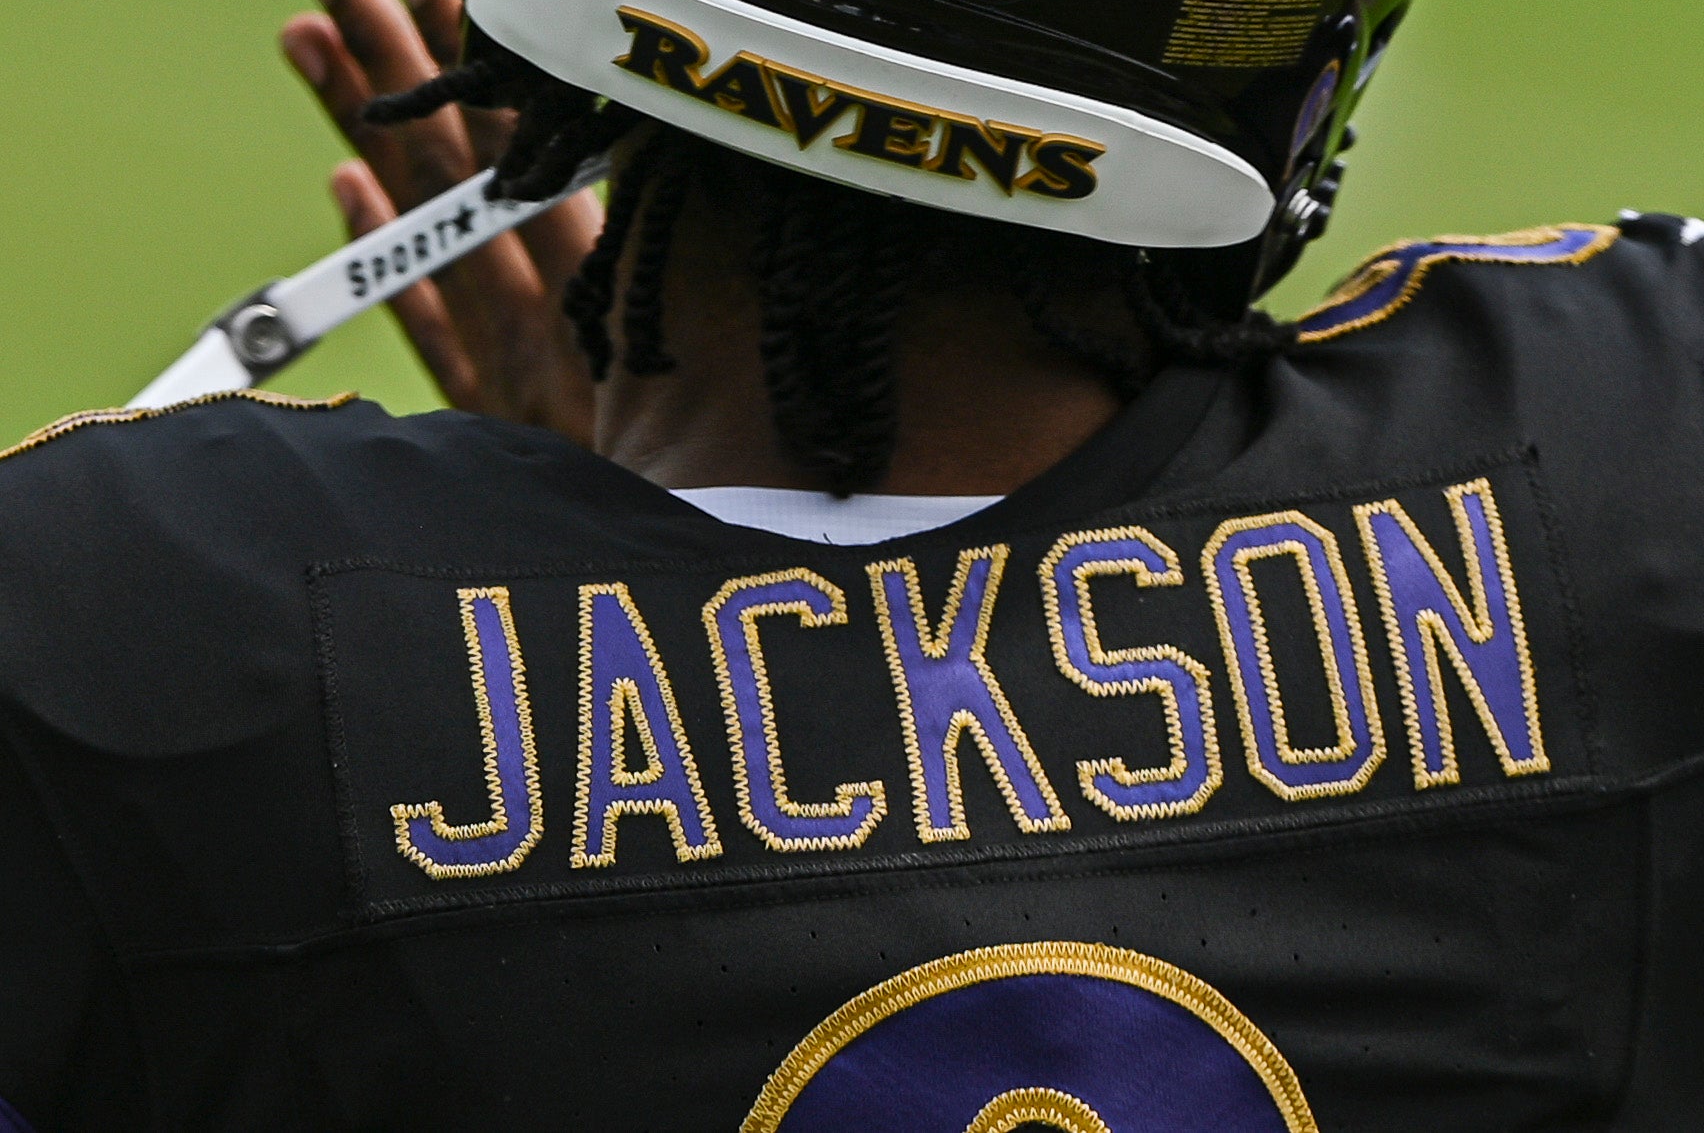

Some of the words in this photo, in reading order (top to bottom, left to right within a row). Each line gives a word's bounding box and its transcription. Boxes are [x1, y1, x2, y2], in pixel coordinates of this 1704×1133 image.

[611, 4, 1107, 200] RAVENS
[348, 219, 455, 297] SPORT
[389, 477, 1549, 880] JACKSON
